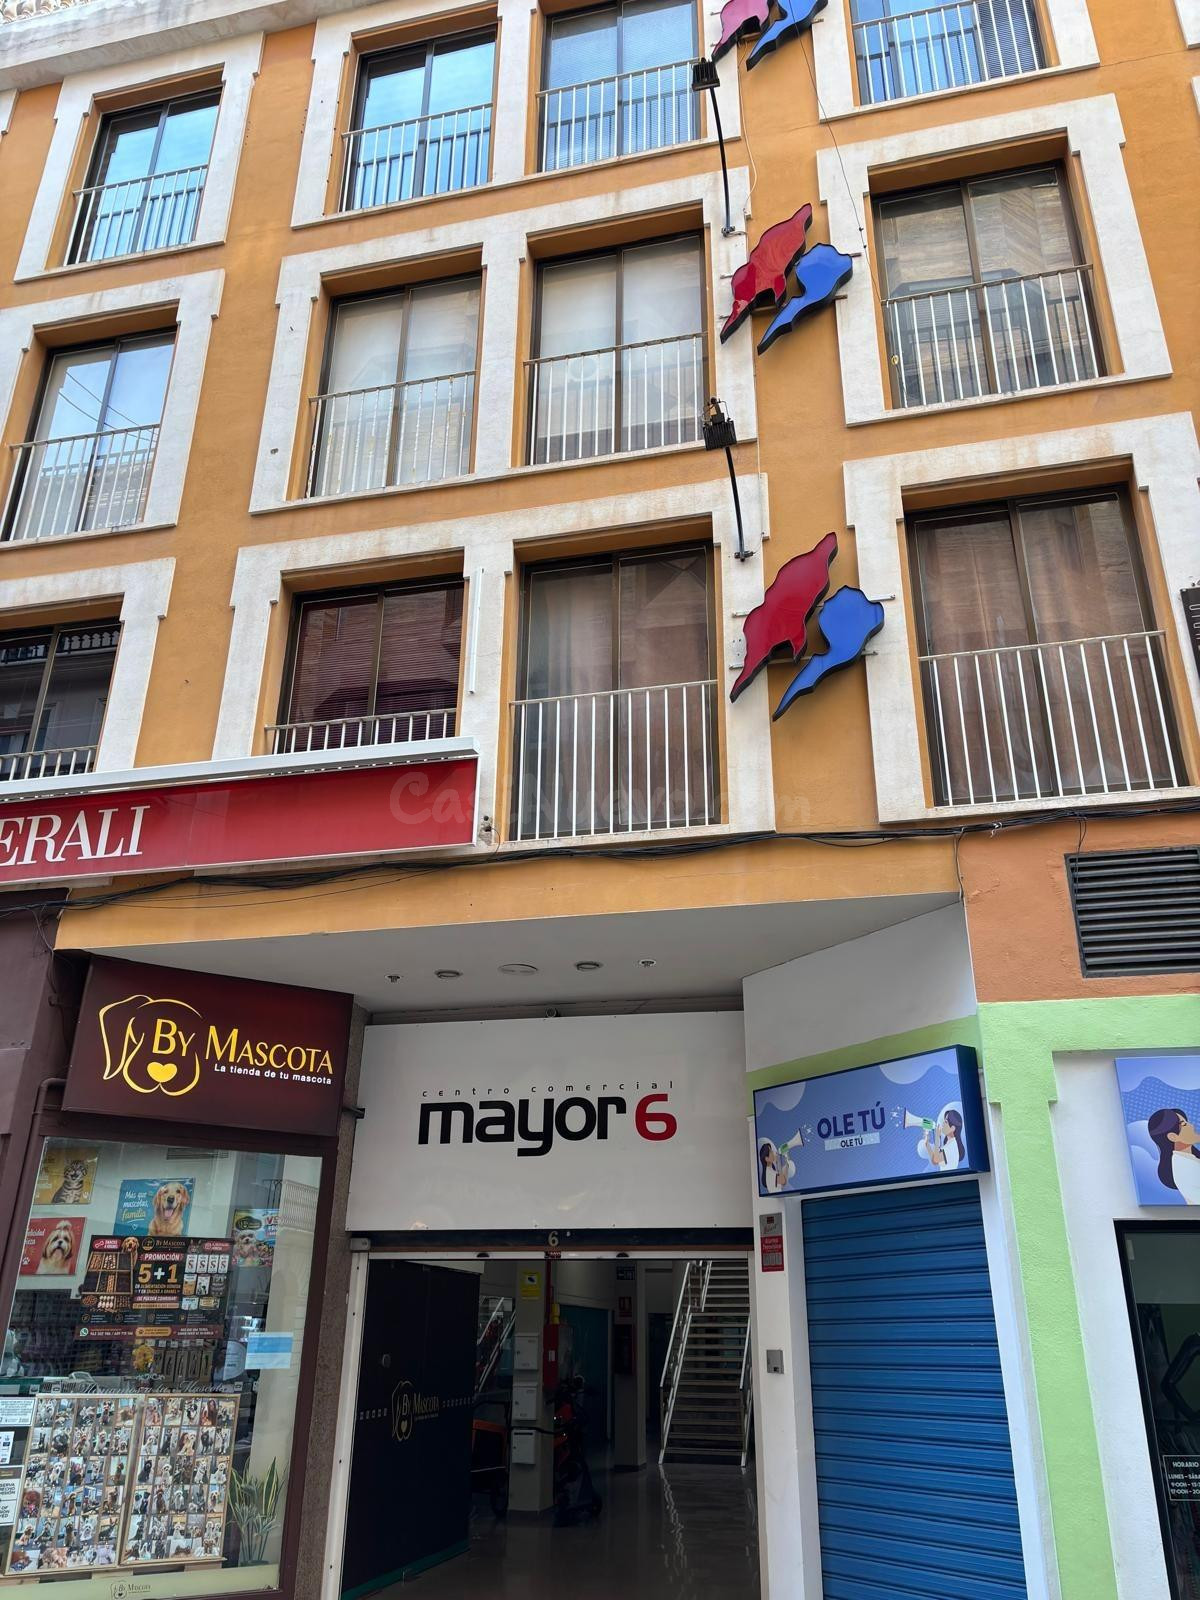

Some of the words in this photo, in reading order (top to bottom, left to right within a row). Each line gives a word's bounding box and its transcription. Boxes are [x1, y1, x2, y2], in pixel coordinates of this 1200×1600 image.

[214, 1063, 226, 1073] La
[230, 1064, 261, 1077] tienda
[264, 1069, 276, 1079] de
[279, 1071, 289, 1081] tu
[292, 1073, 332, 1085] mascota
[422, 1086, 510, 1098] centro
[531, 1080, 673, 1093] comercial
[418, 1095, 627, 1157] mayor
[635, 1093, 678, 1141] 6
[817, 1112, 855, 1139] OLE
[857, 1100, 886, 1132] TÚ
[840, 1138, 854, 1148] OLE
[548, 1230, 559, 1247] 6
[144, 1252, 180, 1261] PROMOCIÓN
